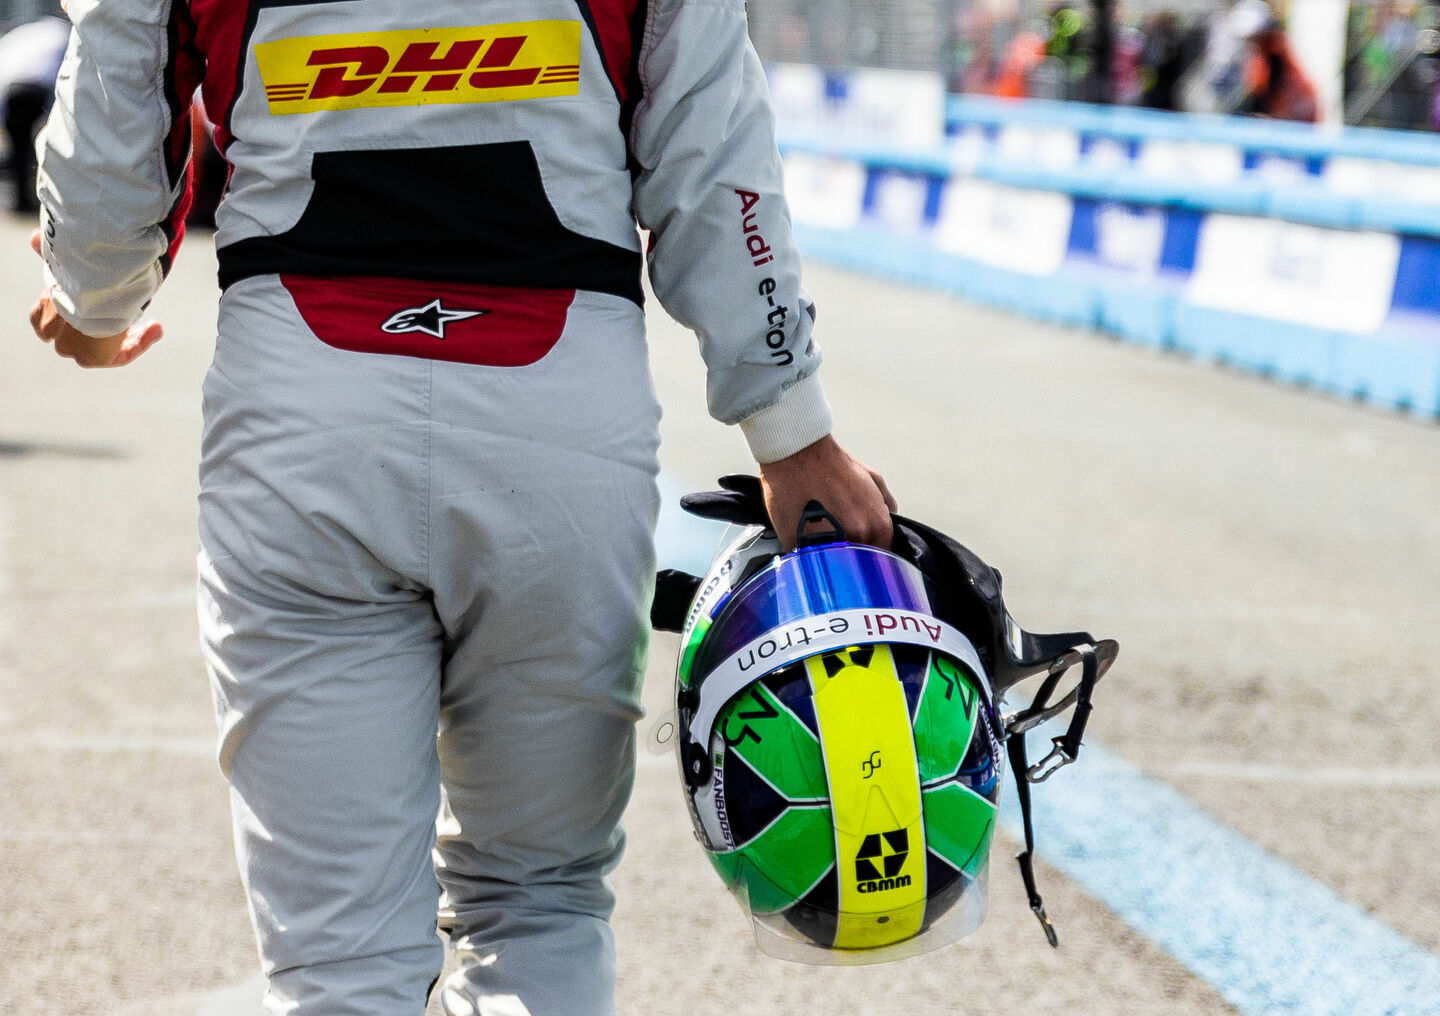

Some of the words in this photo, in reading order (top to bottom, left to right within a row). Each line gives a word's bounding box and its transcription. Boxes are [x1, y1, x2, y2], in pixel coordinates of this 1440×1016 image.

[306, 35, 542, 100] DHL
[734, 188, 774, 267] Audi
[759, 277, 794, 366] e-tron
[737, 617, 850, 672] e-tron
[863, 614, 942, 643] Audi
[713, 768, 737, 851] FANBOOST
